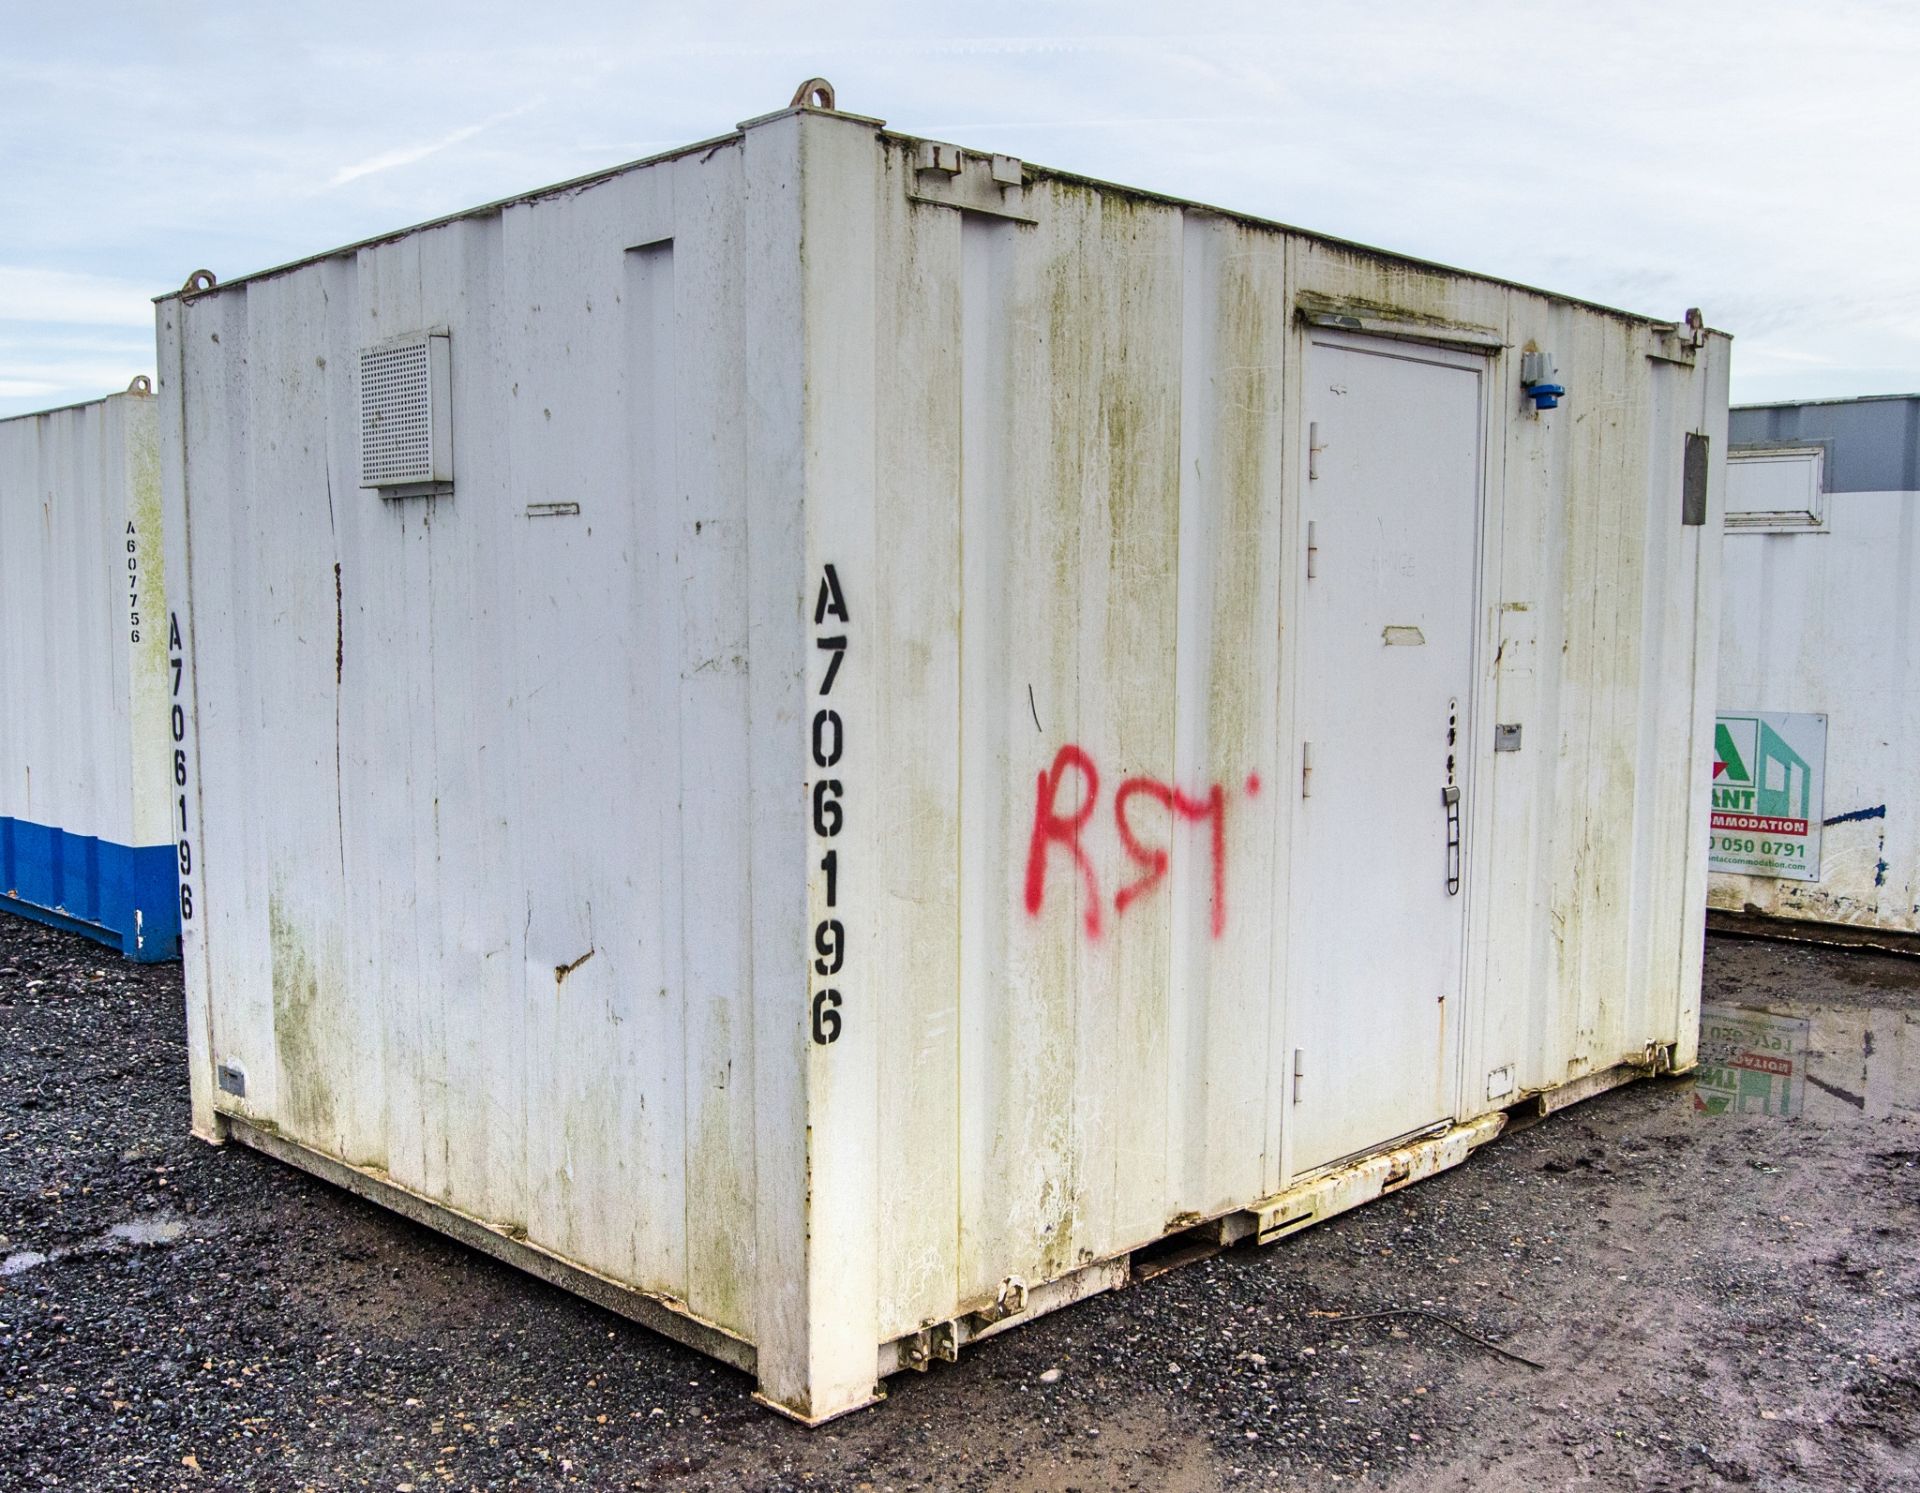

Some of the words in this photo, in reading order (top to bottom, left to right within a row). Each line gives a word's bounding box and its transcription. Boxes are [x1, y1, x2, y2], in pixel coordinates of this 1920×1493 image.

[126, 521, 140, 643] A607756
[169, 612, 192, 920] A706196
[812, 563, 849, 1045] A706196
[1721, 837, 1755, 853] 050
[1761, 841, 1805, 857] 0791
